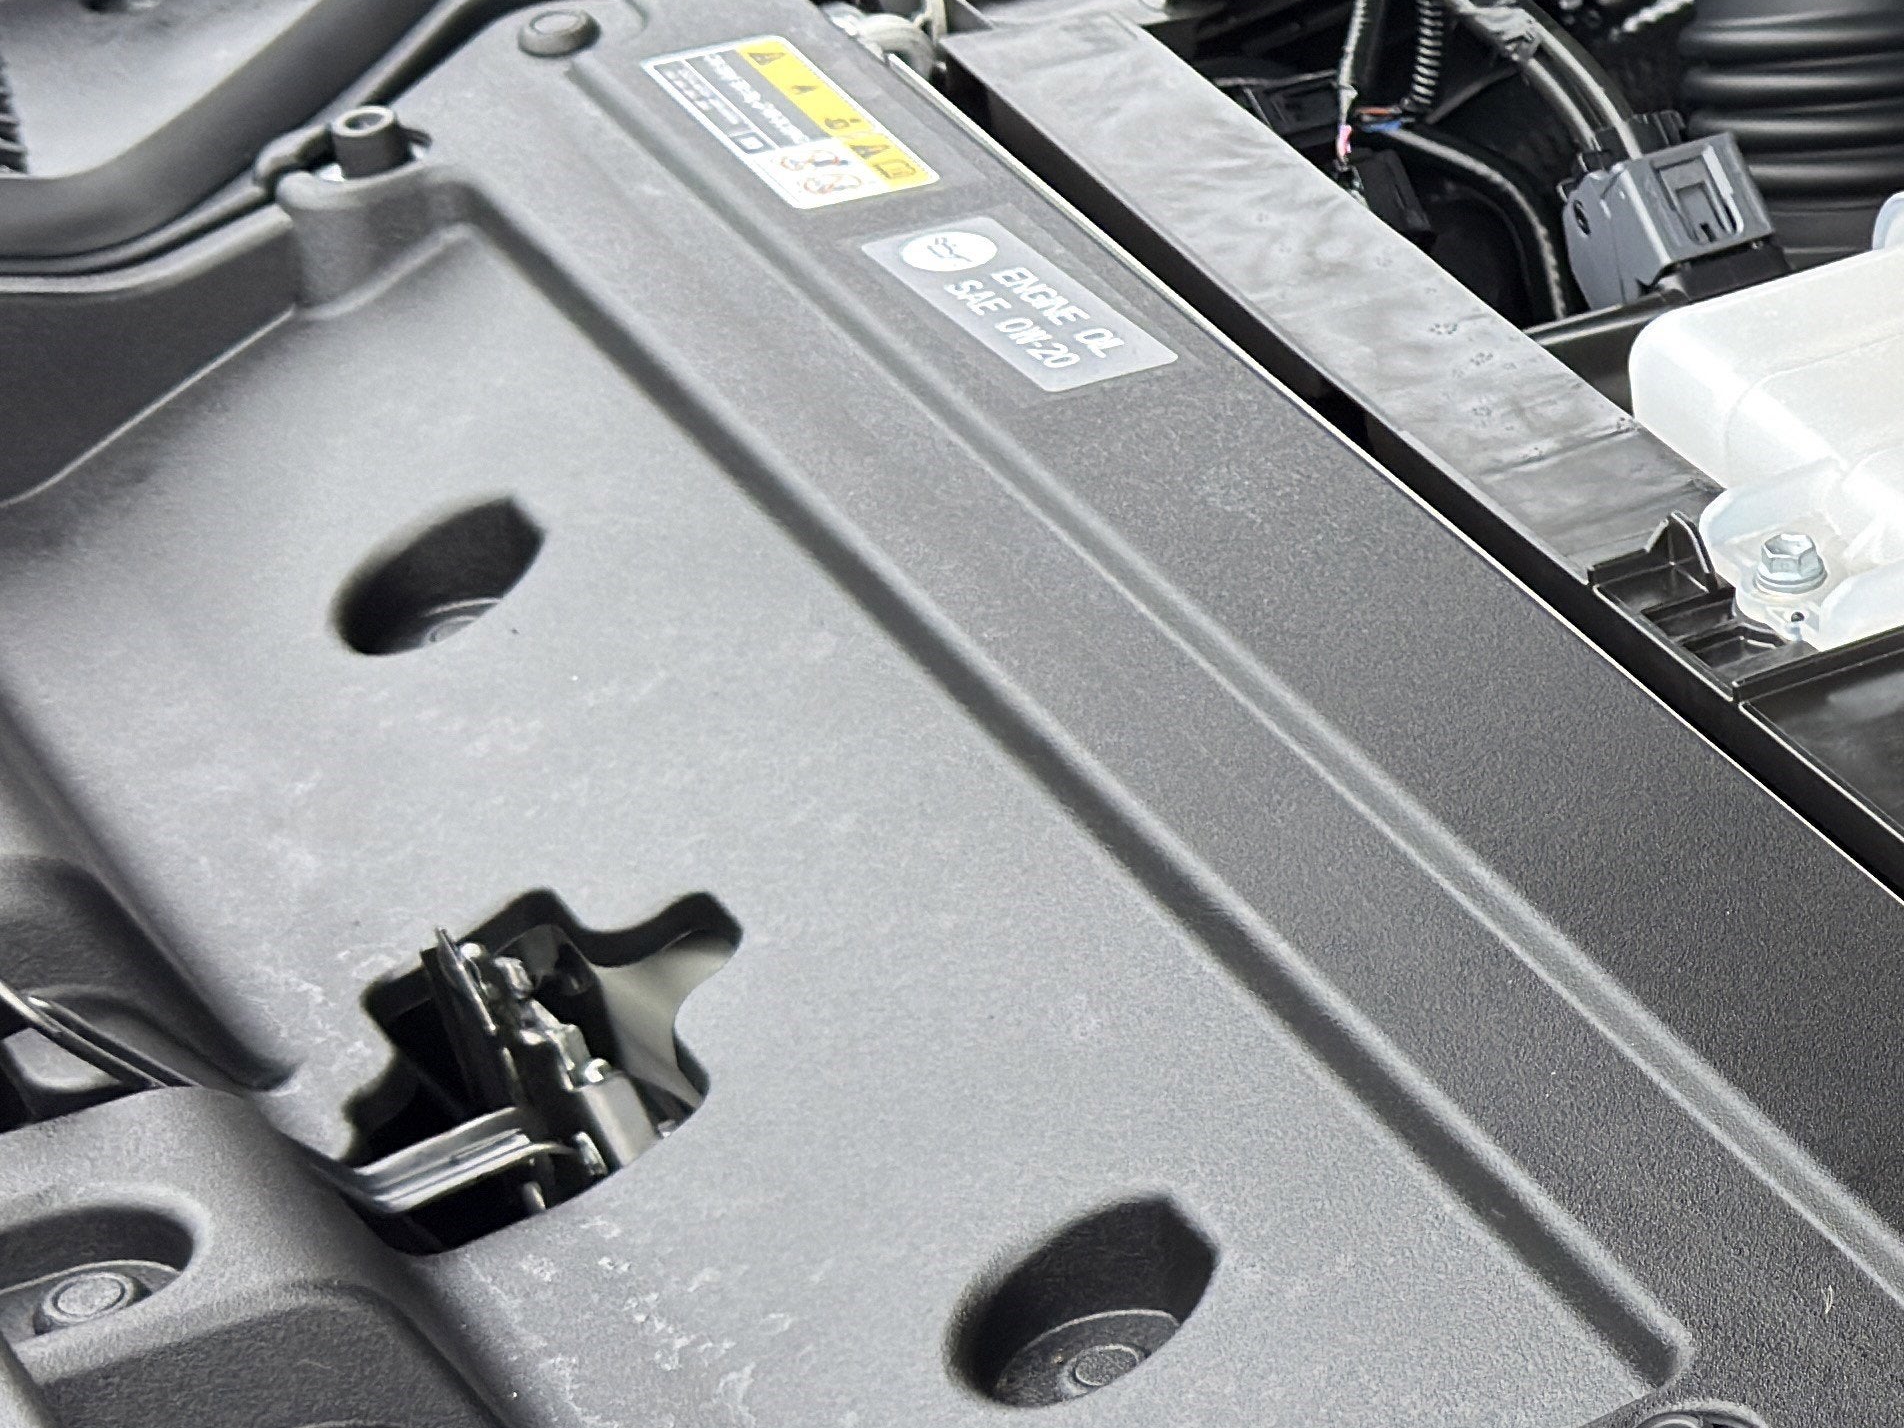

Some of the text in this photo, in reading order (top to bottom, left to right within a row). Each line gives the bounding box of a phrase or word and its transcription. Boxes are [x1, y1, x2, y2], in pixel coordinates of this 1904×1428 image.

[944, 279, 1081, 369] SAE 0W-20
[991, 267, 1125, 359] ENGINE OIL
